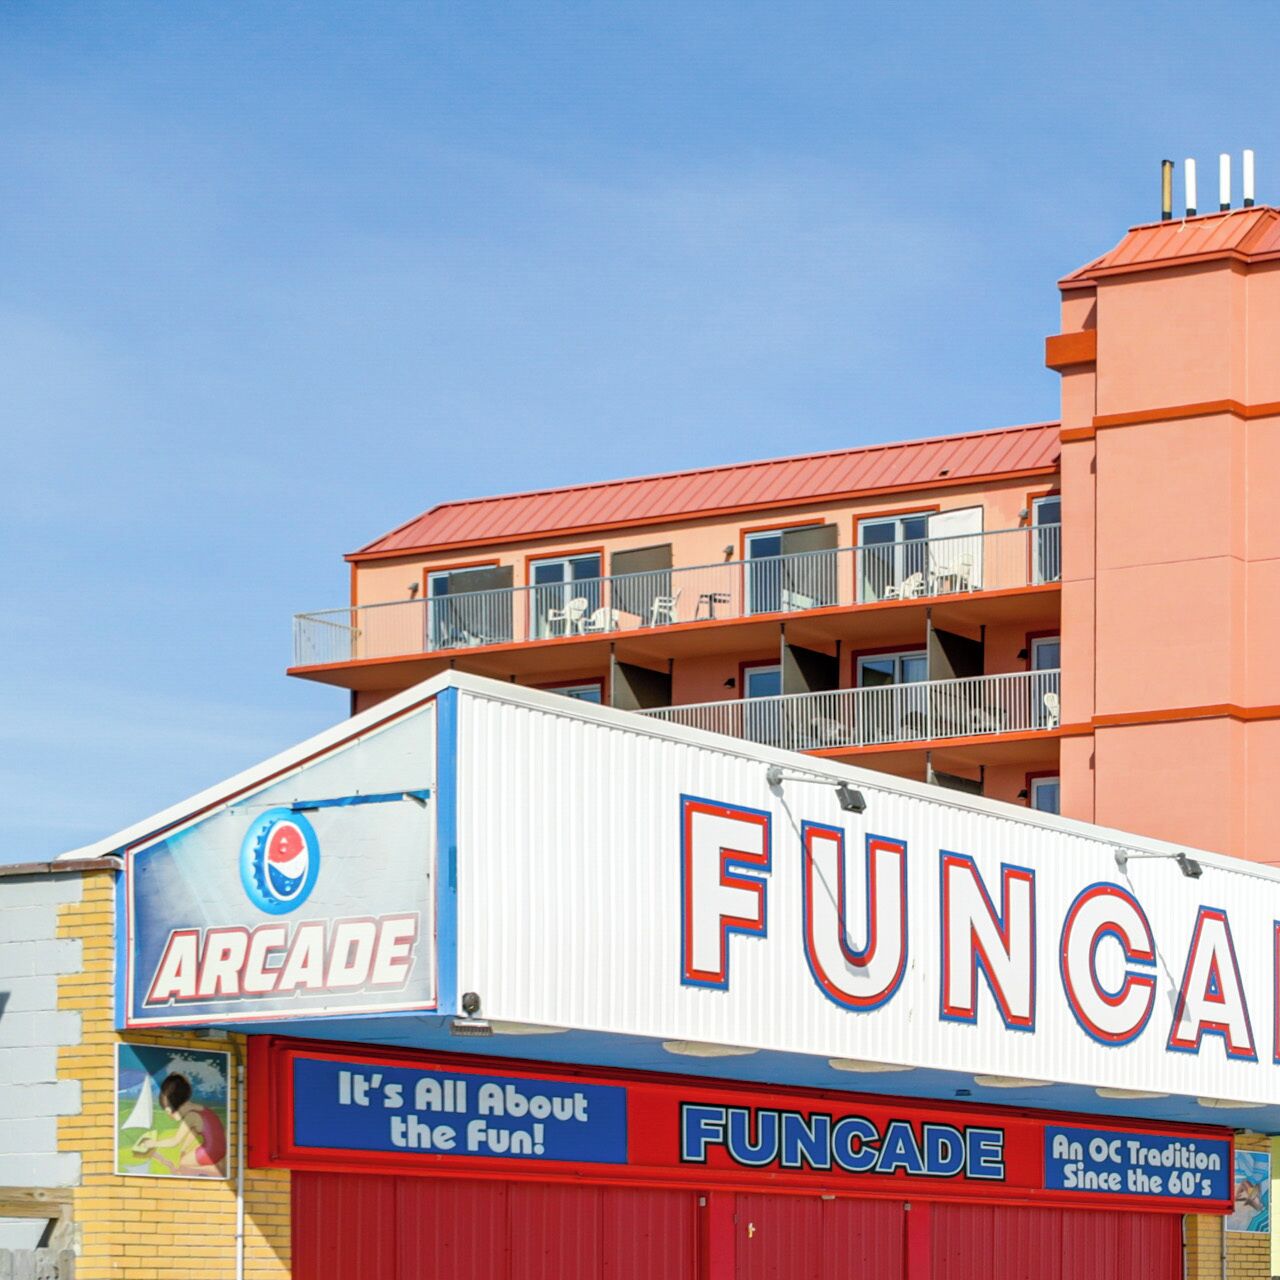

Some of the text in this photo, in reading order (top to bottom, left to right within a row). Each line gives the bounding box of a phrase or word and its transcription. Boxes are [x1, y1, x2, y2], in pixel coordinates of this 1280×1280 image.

[143, 912, 420, 1008] ARCADE
[339, 1071, 588, 1122] It's All About
[390, 1114, 456, 1150] the
[680, 1101, 1006, 1181] FUNCADE
[1052, 1134, 1221, 1171] An OC Tradition
[1063, 1162, 1212, 1196] Since the 60's
